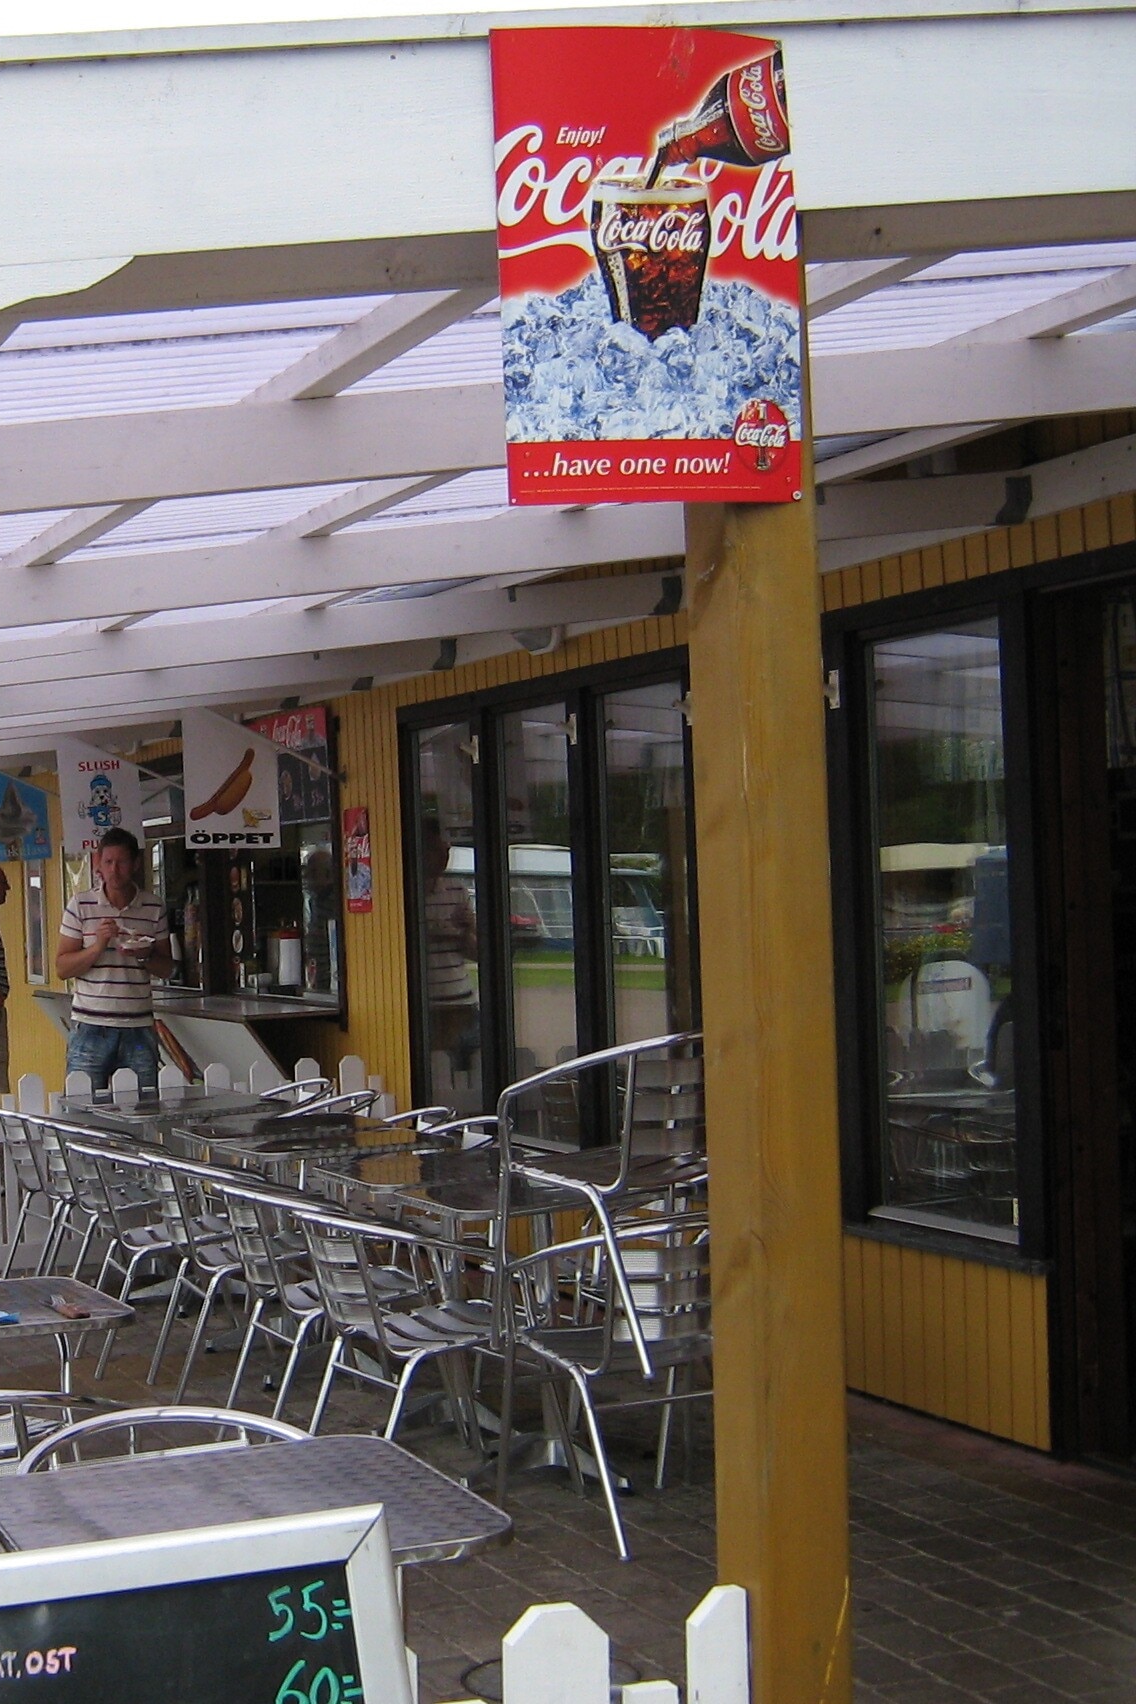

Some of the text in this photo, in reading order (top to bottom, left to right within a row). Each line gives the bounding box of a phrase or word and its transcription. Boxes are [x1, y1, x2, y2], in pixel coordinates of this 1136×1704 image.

[739, 65, 784, 152] Coca-Cola
[555, 126, 605, 147] Enjoy!
[597, 210, 704, 252] Coca-Cola
[619, 456, 667, 476] one
[674, 452, 731, 475] now!
[78, 759, 121, 772] SLUSH
[190, 829, 275, 845] ÖPPET
[25, 1646, 78, 1675] OST
